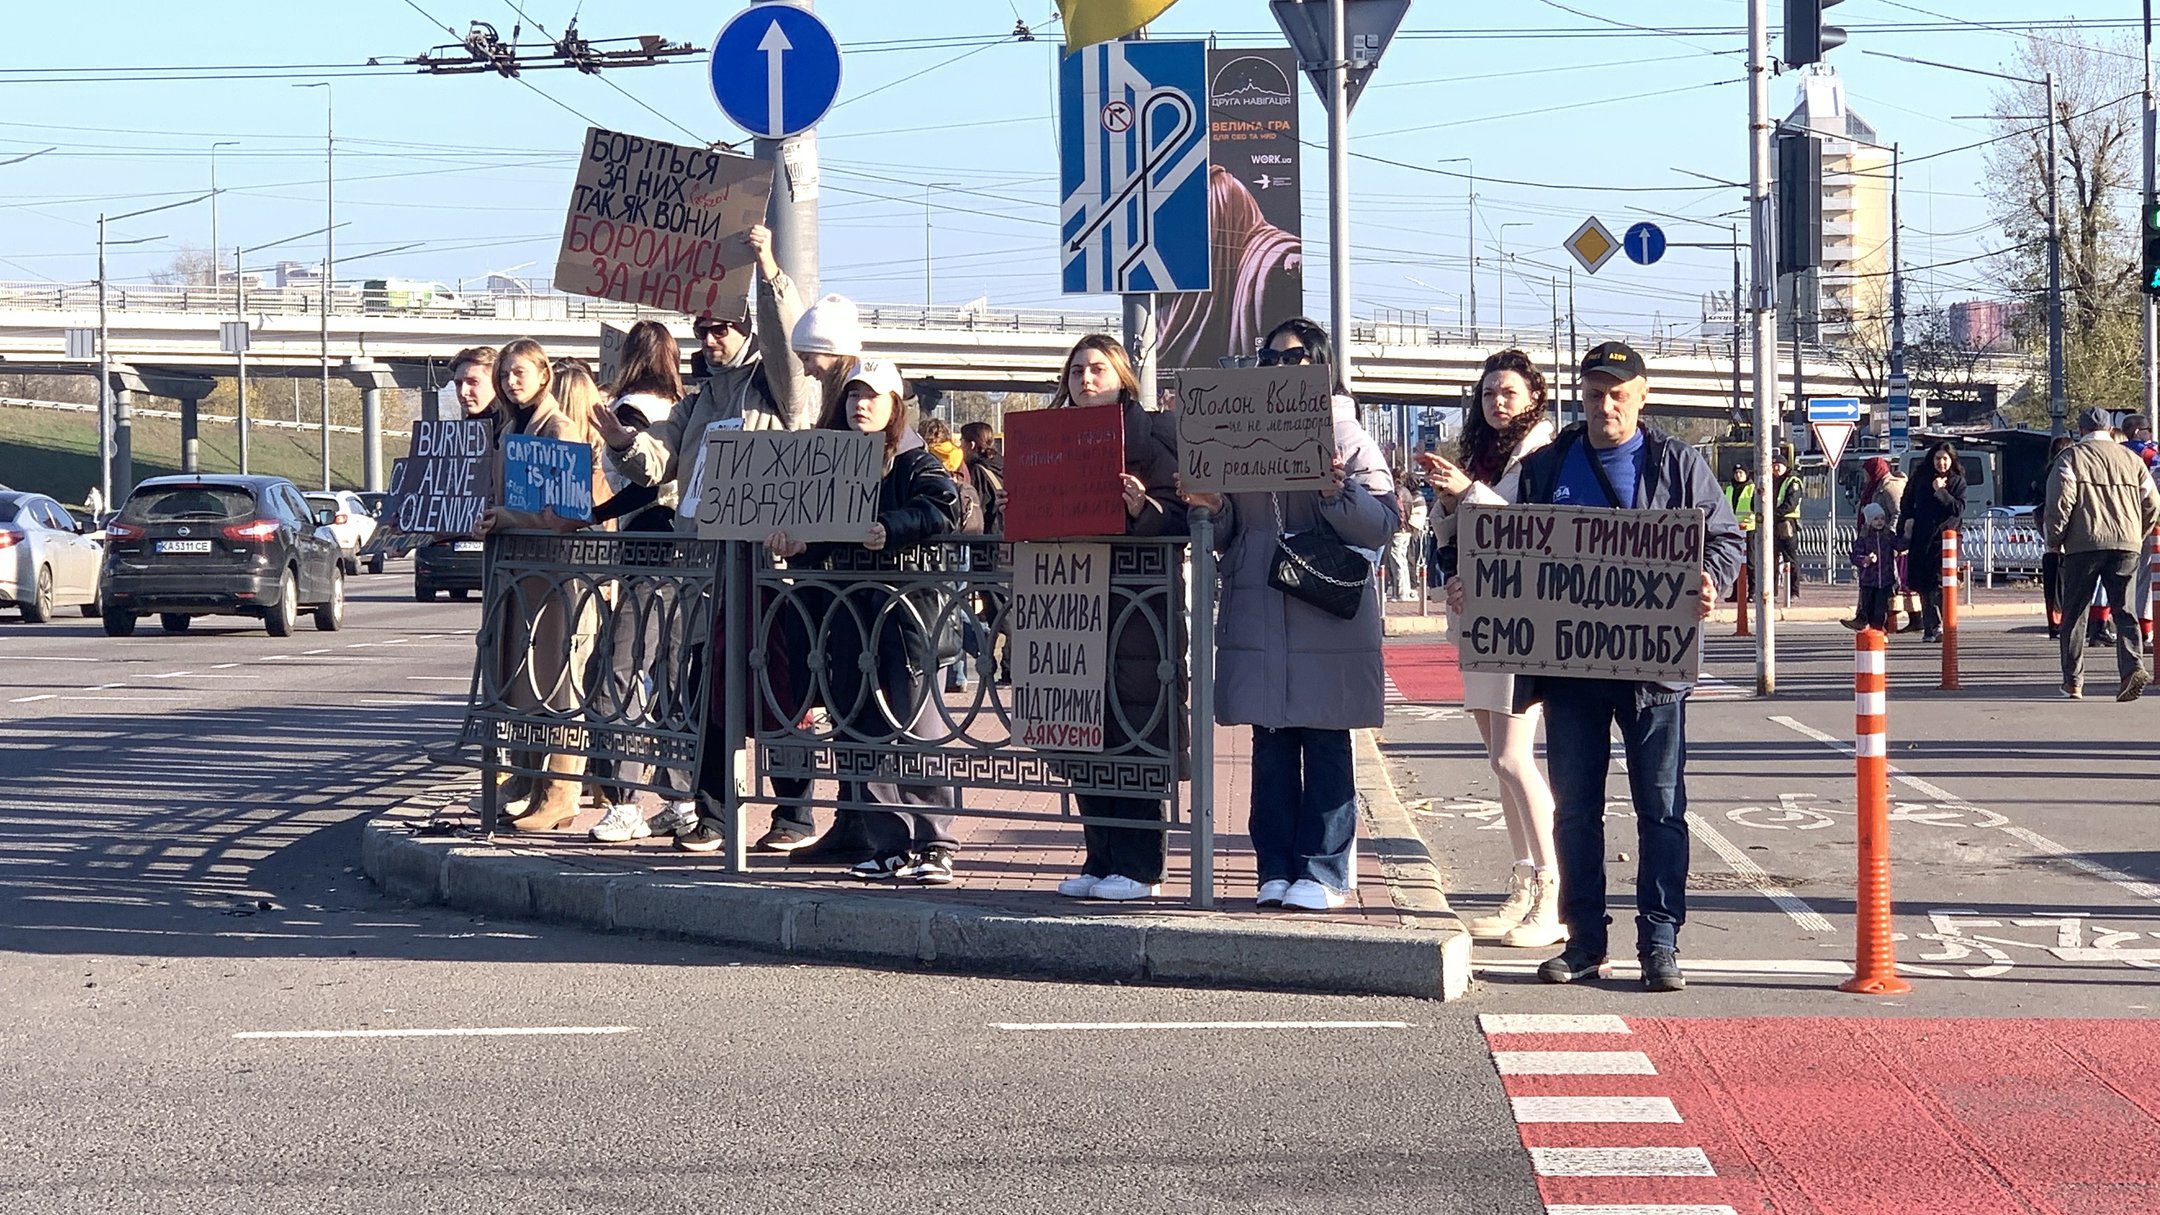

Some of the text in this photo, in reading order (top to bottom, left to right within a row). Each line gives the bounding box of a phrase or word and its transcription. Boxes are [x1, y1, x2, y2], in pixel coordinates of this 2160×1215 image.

[1212, 97, 1291, 107] ДРУГА НАВІГАЦІЯ
[1268, 121, 1290, 130] ГРА
[1251, 155, 1292, 164] WORK.ua
[598, 162, 687, 203] ЗА НИХ
[653, 201, 721, 240] ВОНИ
[568, 215, 726, 281] БОРОЛИСЬ
[586, 257, 718, 318] ЗА НАС!
[1187, 385, 1255, 416] Полон
[418, 421, 487, 457] BURNED
[1247, 420, 1261, 432] не
[709, 437, 756, 480] ТИ
[1188, 449, 1212, 479] Це
[419, 459, 477, 496] ALIVE
[399, 494, 486, 533] OLENIVKA
[700, 476, 835, 526] ЗАВДЯКИ
[1035, 553, 1091, 586] НАМ
[1476, 558, 1522, 599] МИ
[1016, 593, 1102, 632] ВАЖЛИВА
[1029, 640, 1086, 676] ВАША
[1556, 619, 1696, 665] БОРОТЬБУ
[1023, 724, 1102, 747] ДЯКУЄМО
